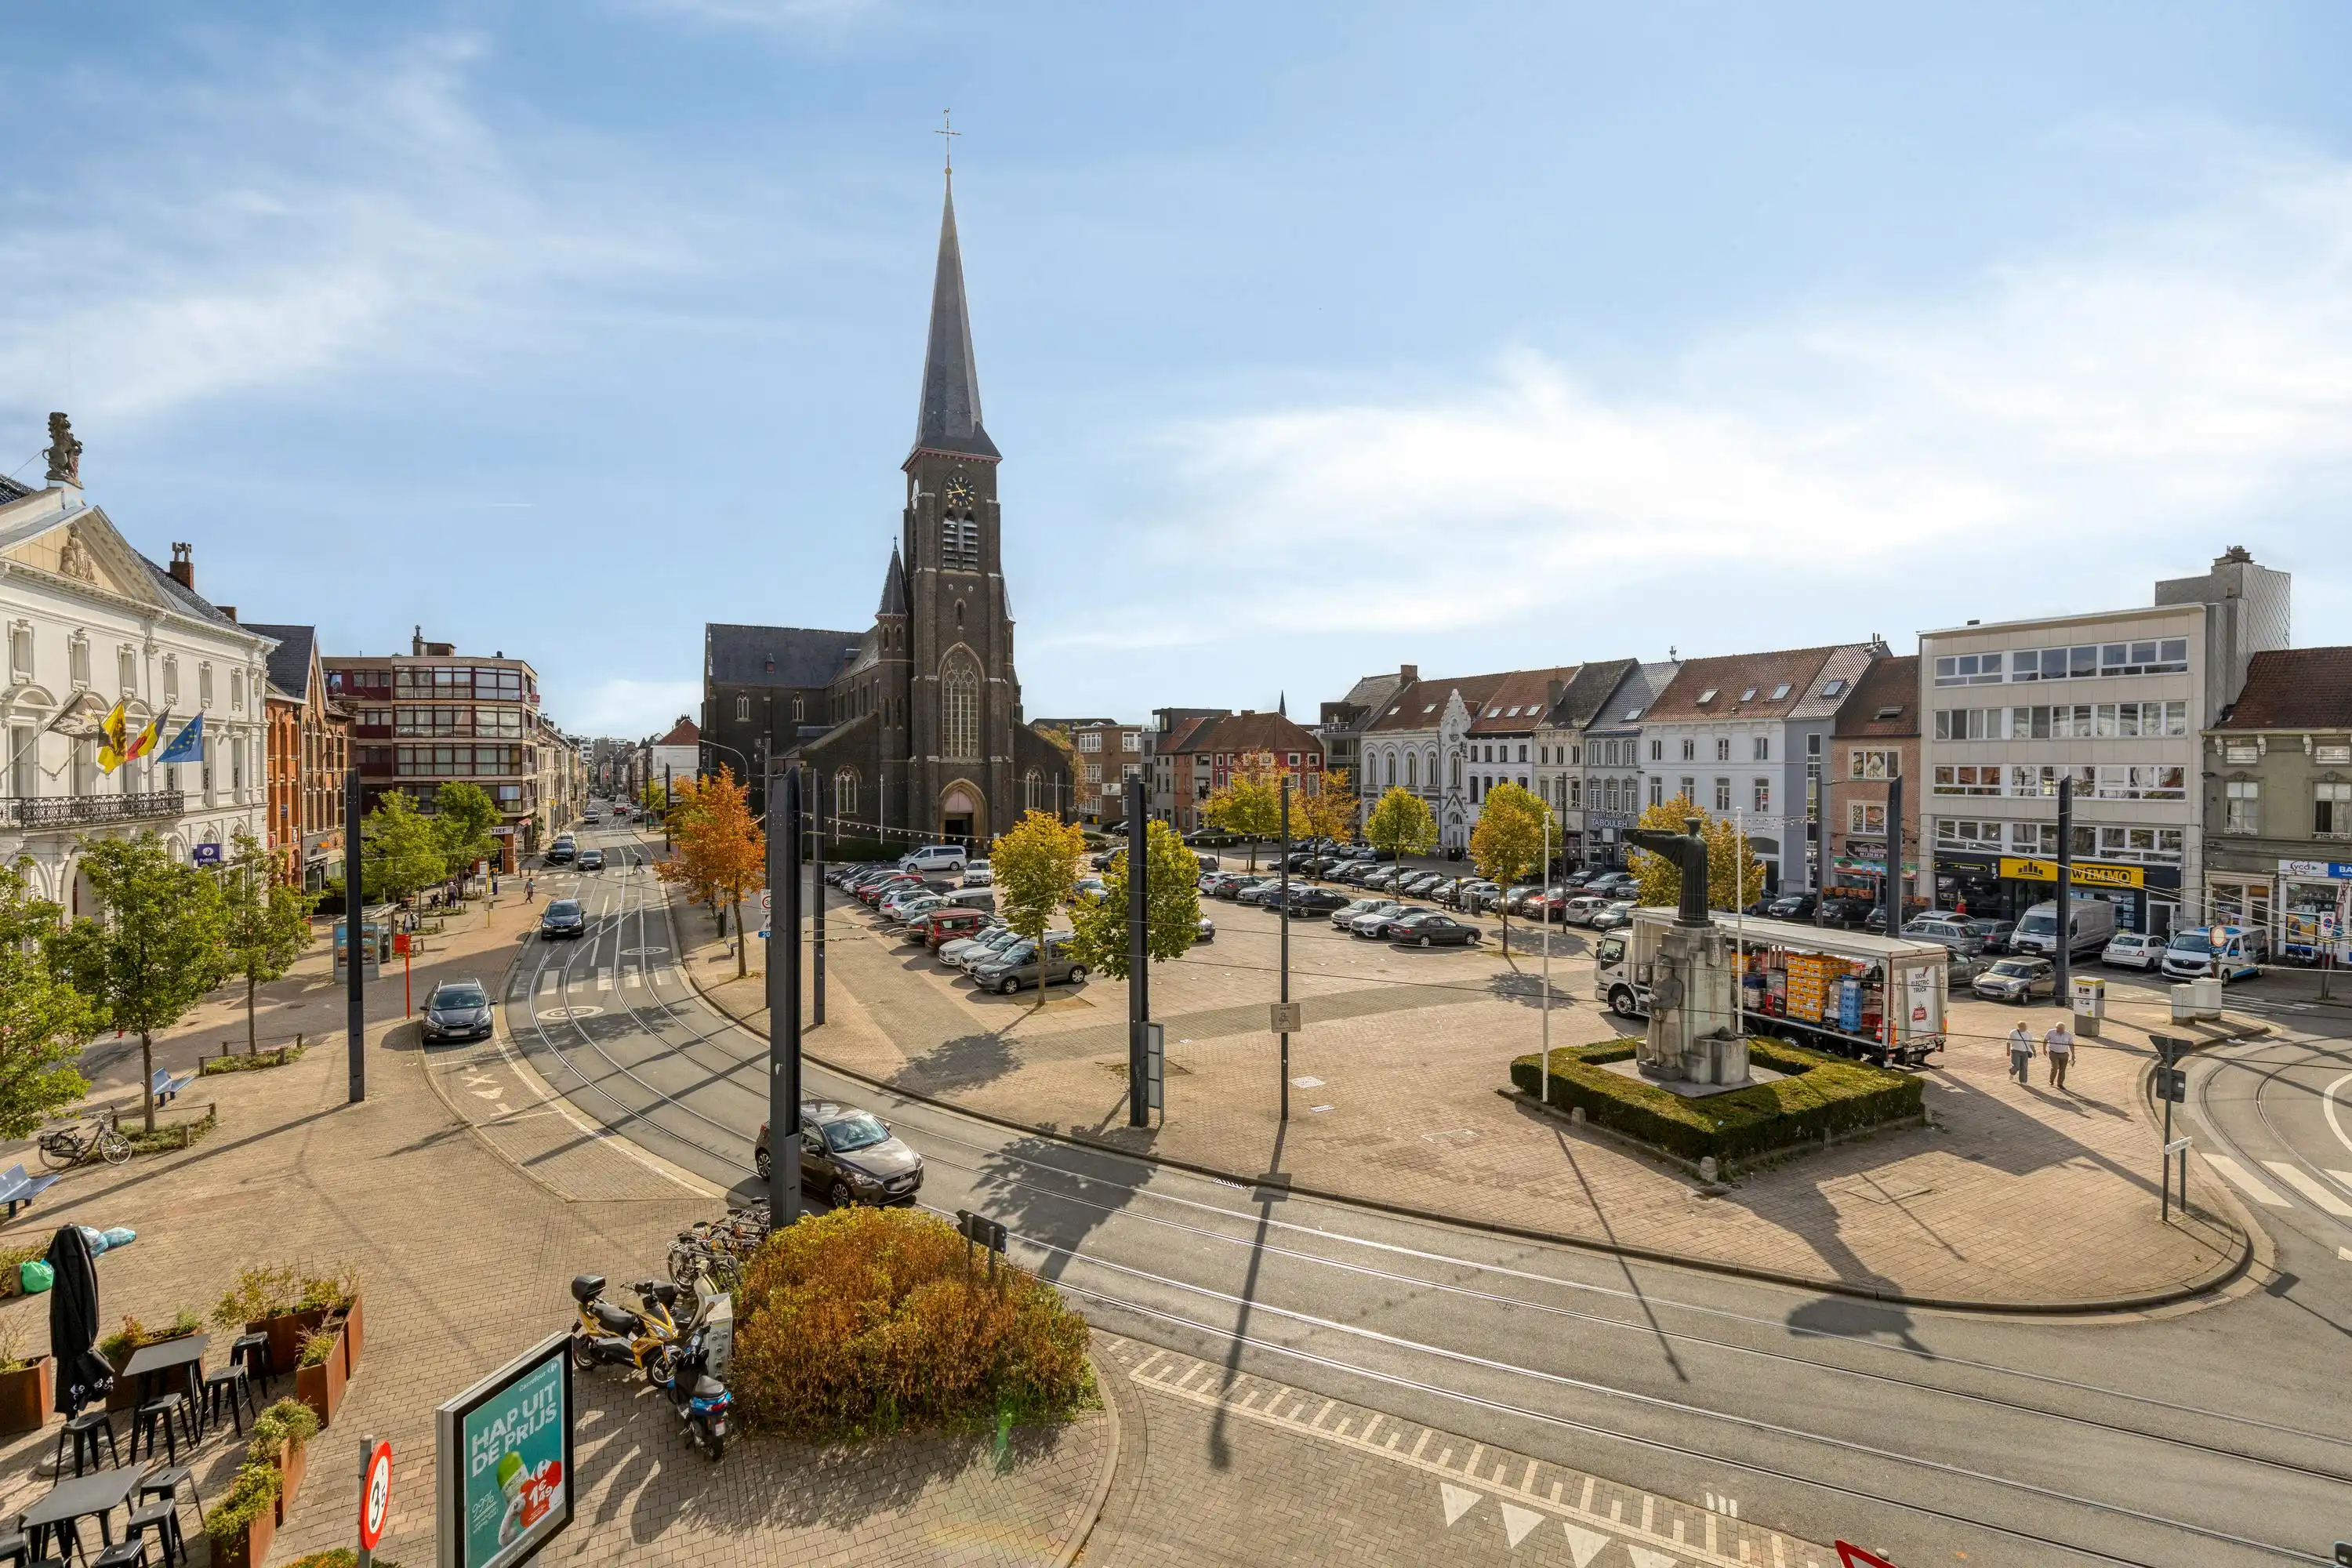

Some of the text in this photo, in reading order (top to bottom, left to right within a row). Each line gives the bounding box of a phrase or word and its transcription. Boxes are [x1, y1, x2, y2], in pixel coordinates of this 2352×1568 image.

[1592, 819, 1628, 828] TABOULEH
[2086, 869, 2131, 883] IMMO
[519, 1370, 546, 1392] Carrefour
[472, 1380, 557, 1457] HAP UIT
[472, 1402, 557, 1478] DE PRIJS
